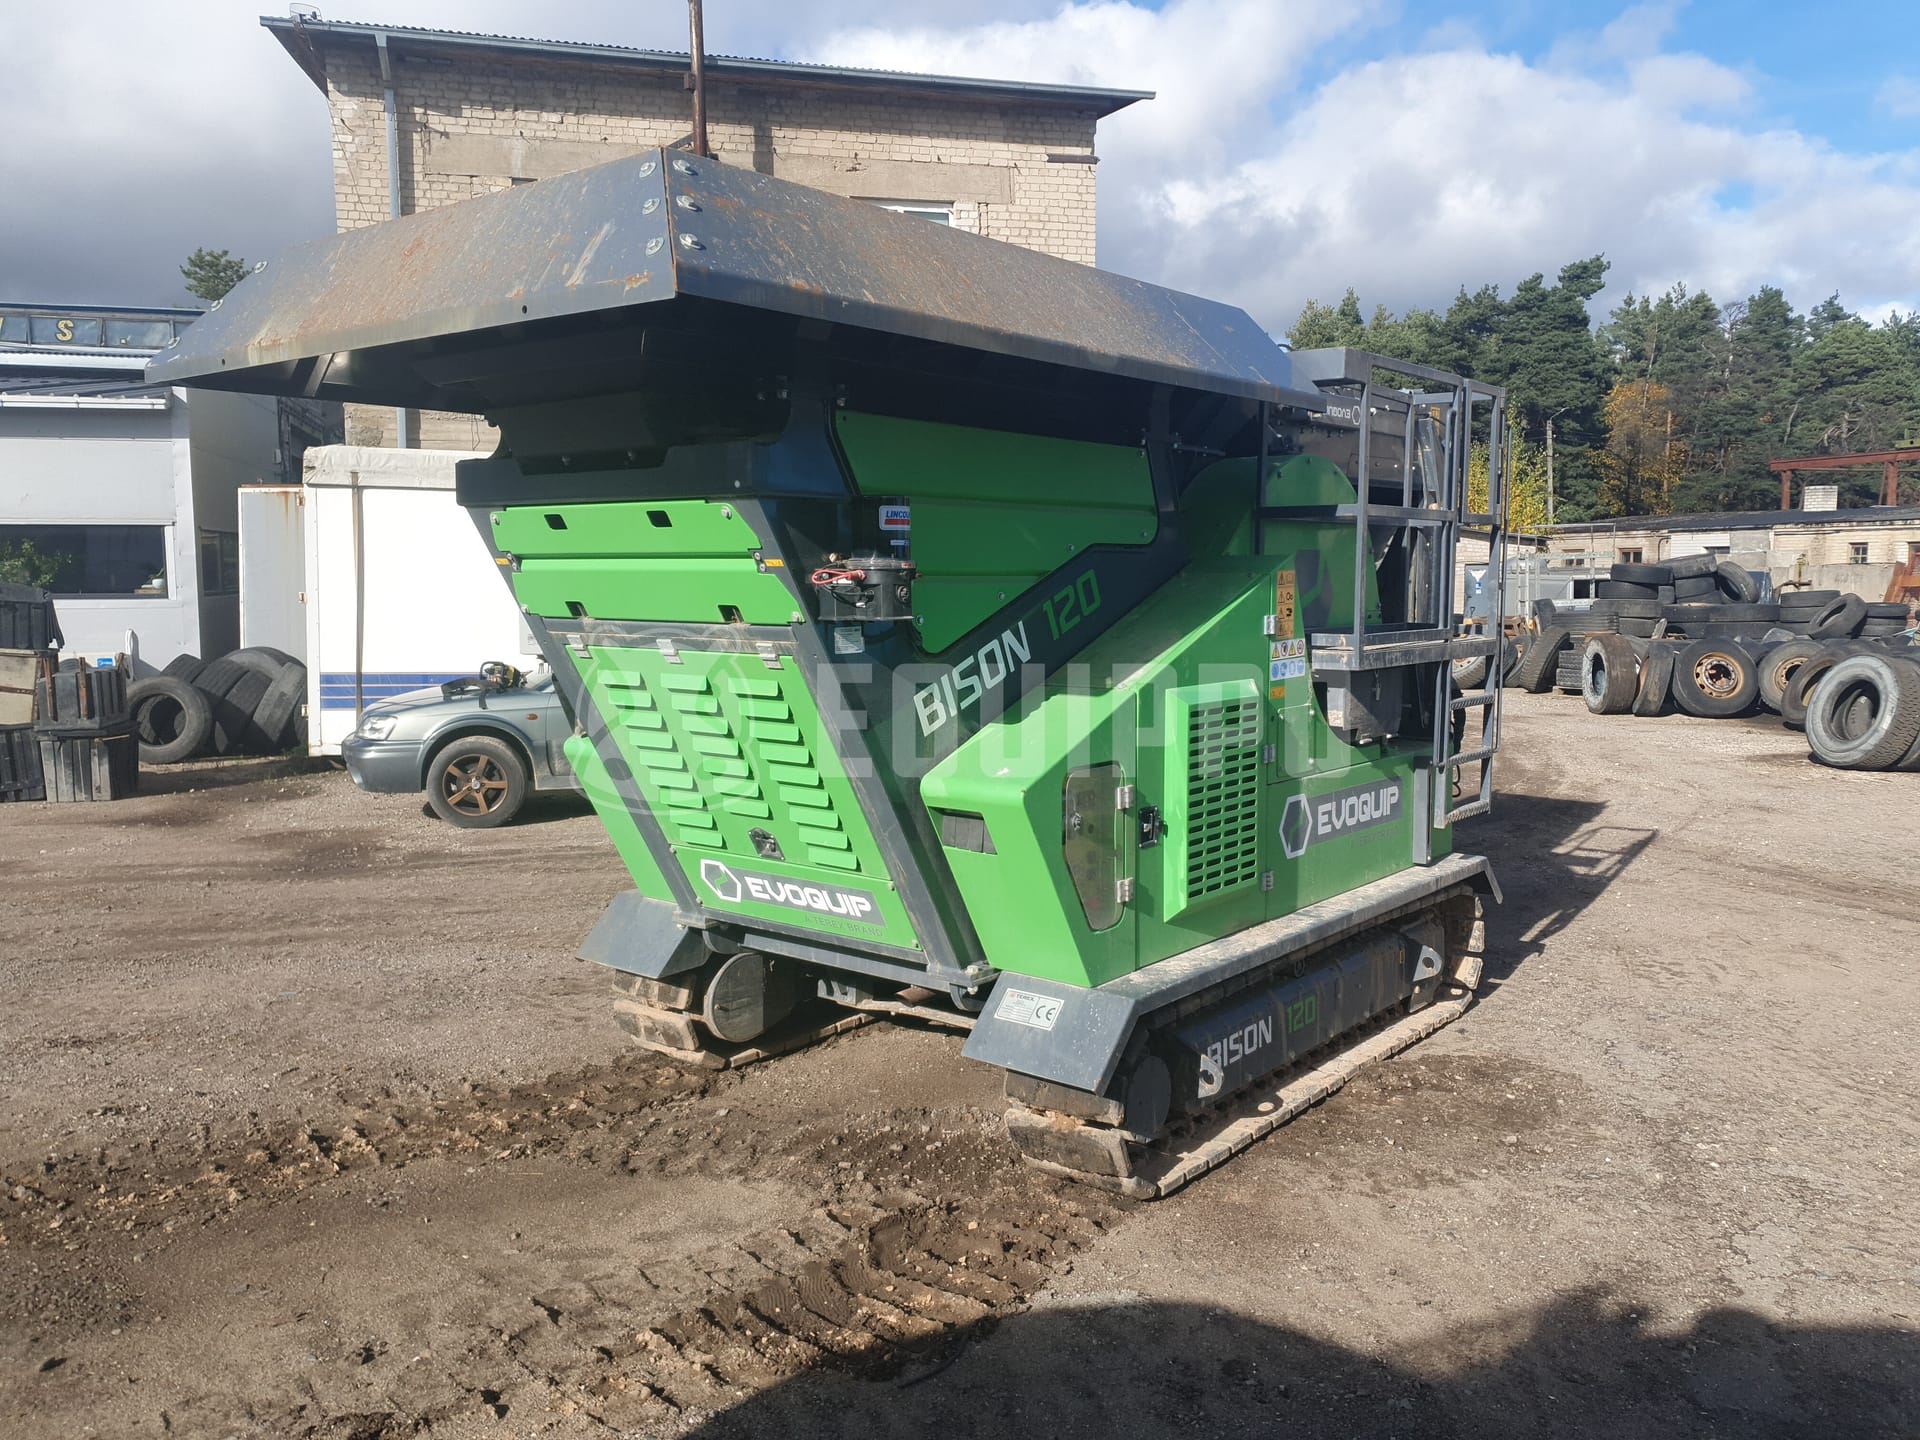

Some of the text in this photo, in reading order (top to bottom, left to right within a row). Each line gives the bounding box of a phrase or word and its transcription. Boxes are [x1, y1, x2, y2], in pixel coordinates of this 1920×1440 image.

[913, 568, 1101, 737] BISON 120
[1317, 785, 1399, 835] EVOQUIP
[744, 876, 872, 917] EVOQUIP
[1035, 1004, 1057, 1022] CE
[1287, 994, 1316, 1033] 120
